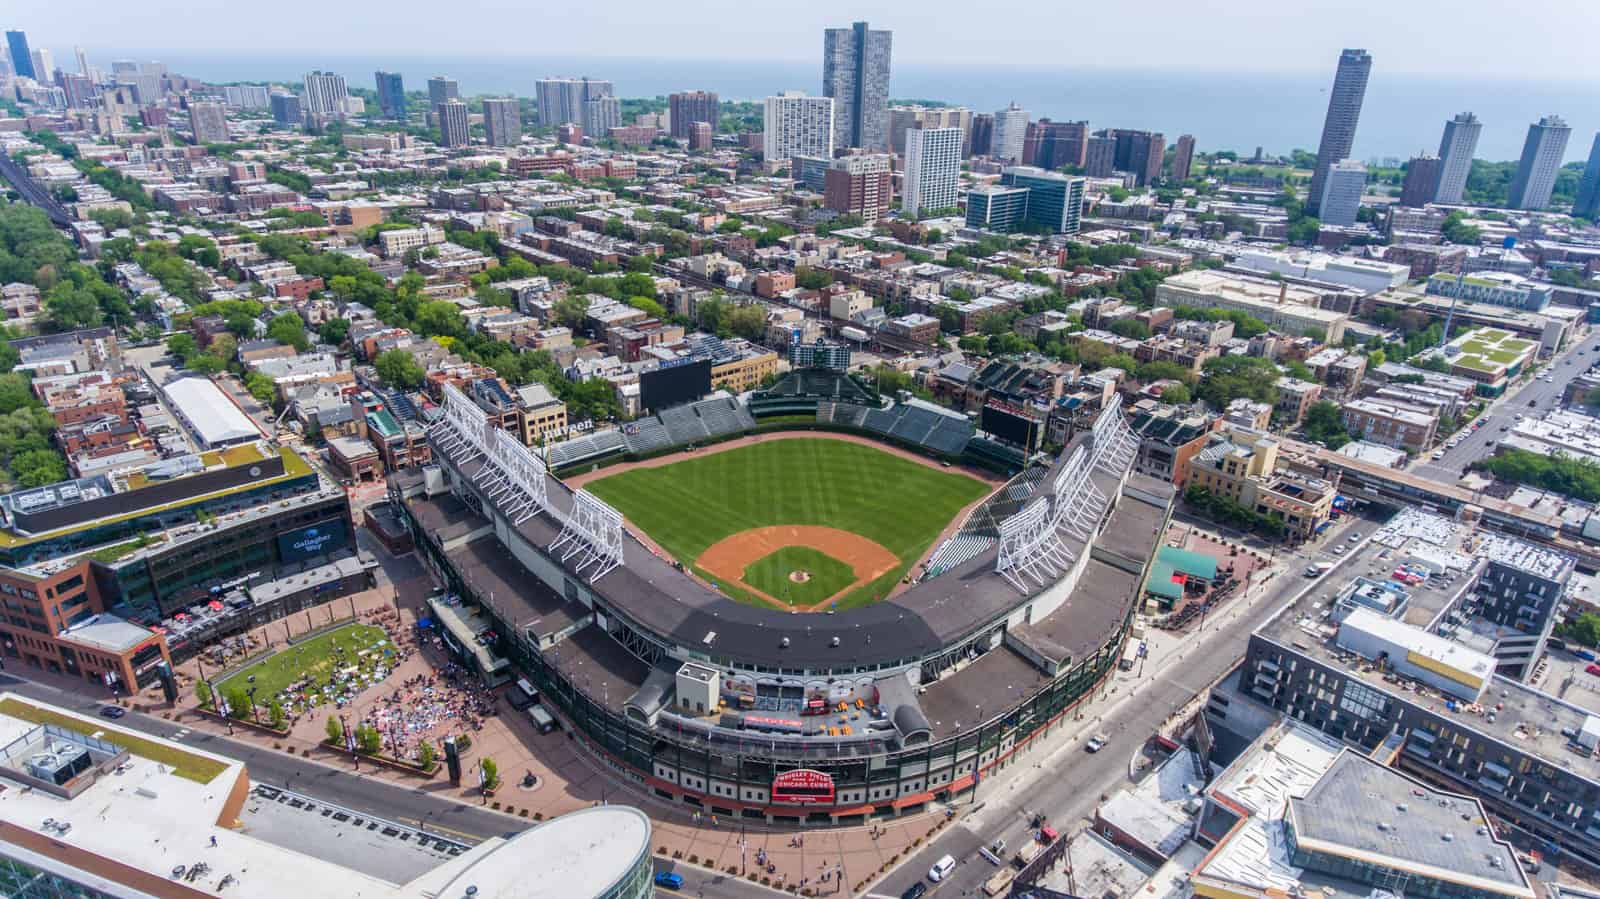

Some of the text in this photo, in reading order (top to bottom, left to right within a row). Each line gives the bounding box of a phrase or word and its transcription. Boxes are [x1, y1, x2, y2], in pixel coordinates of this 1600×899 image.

[293, 534, 331, 549] Gallagher
[779, 772, 830, 781] WRIGLEY FIELD
